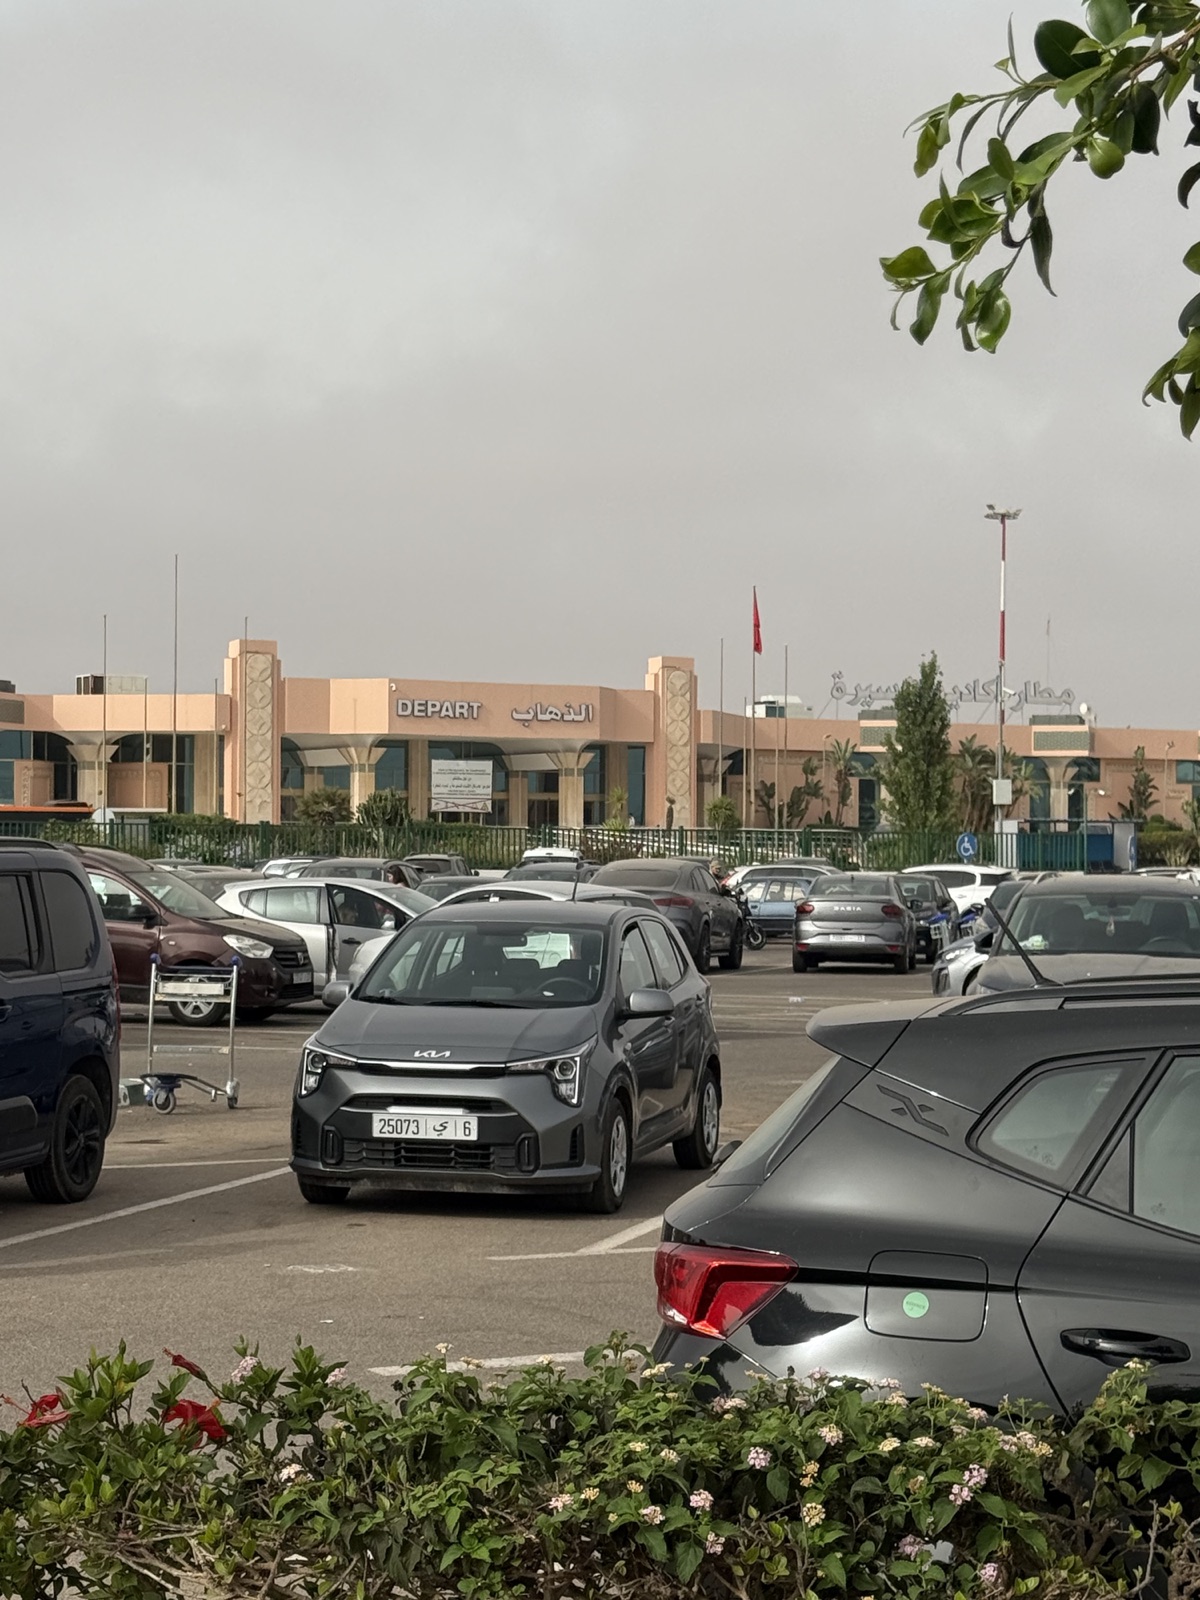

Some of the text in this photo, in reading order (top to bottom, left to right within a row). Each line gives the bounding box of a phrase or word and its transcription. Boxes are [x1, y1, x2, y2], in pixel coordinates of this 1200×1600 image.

[1009, 680, 1075, 712] مطار
[397, 699, 481, 719] DEPART
[511, 702, 593, 727] الذهاب
[413, 1050, 451, 1058] KIA
[379, 1118, 420, 1135] 25073
[463, 1121, 472, 1137] 6
